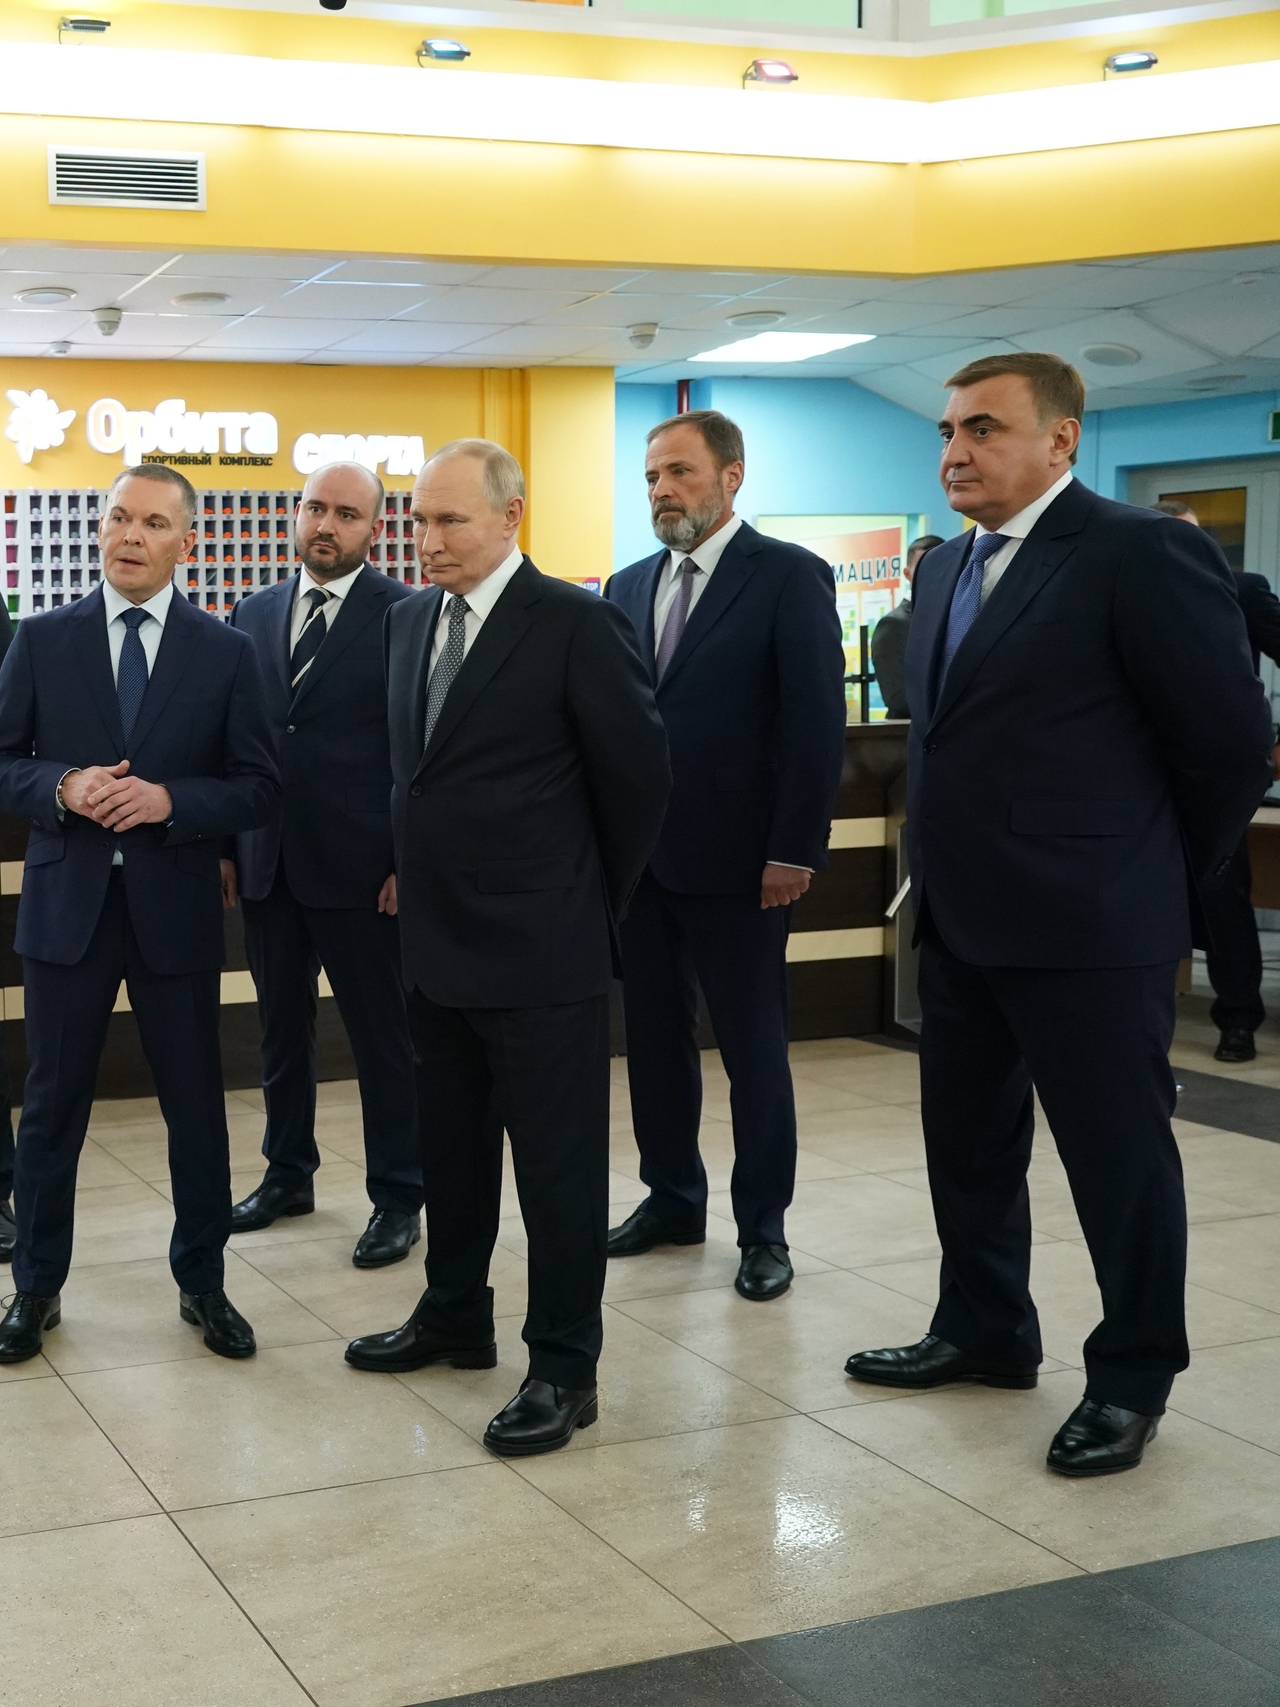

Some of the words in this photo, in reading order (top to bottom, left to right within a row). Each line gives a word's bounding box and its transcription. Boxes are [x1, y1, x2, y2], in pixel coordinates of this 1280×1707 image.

[87, 397, 278, 467] Орбита
[141, 453, 213, 467] СПОРТИВНЫЙ
[219, 455, 273, 467] КОМПЛЕКС
[293, 433, 425, 475] СПОРТА
